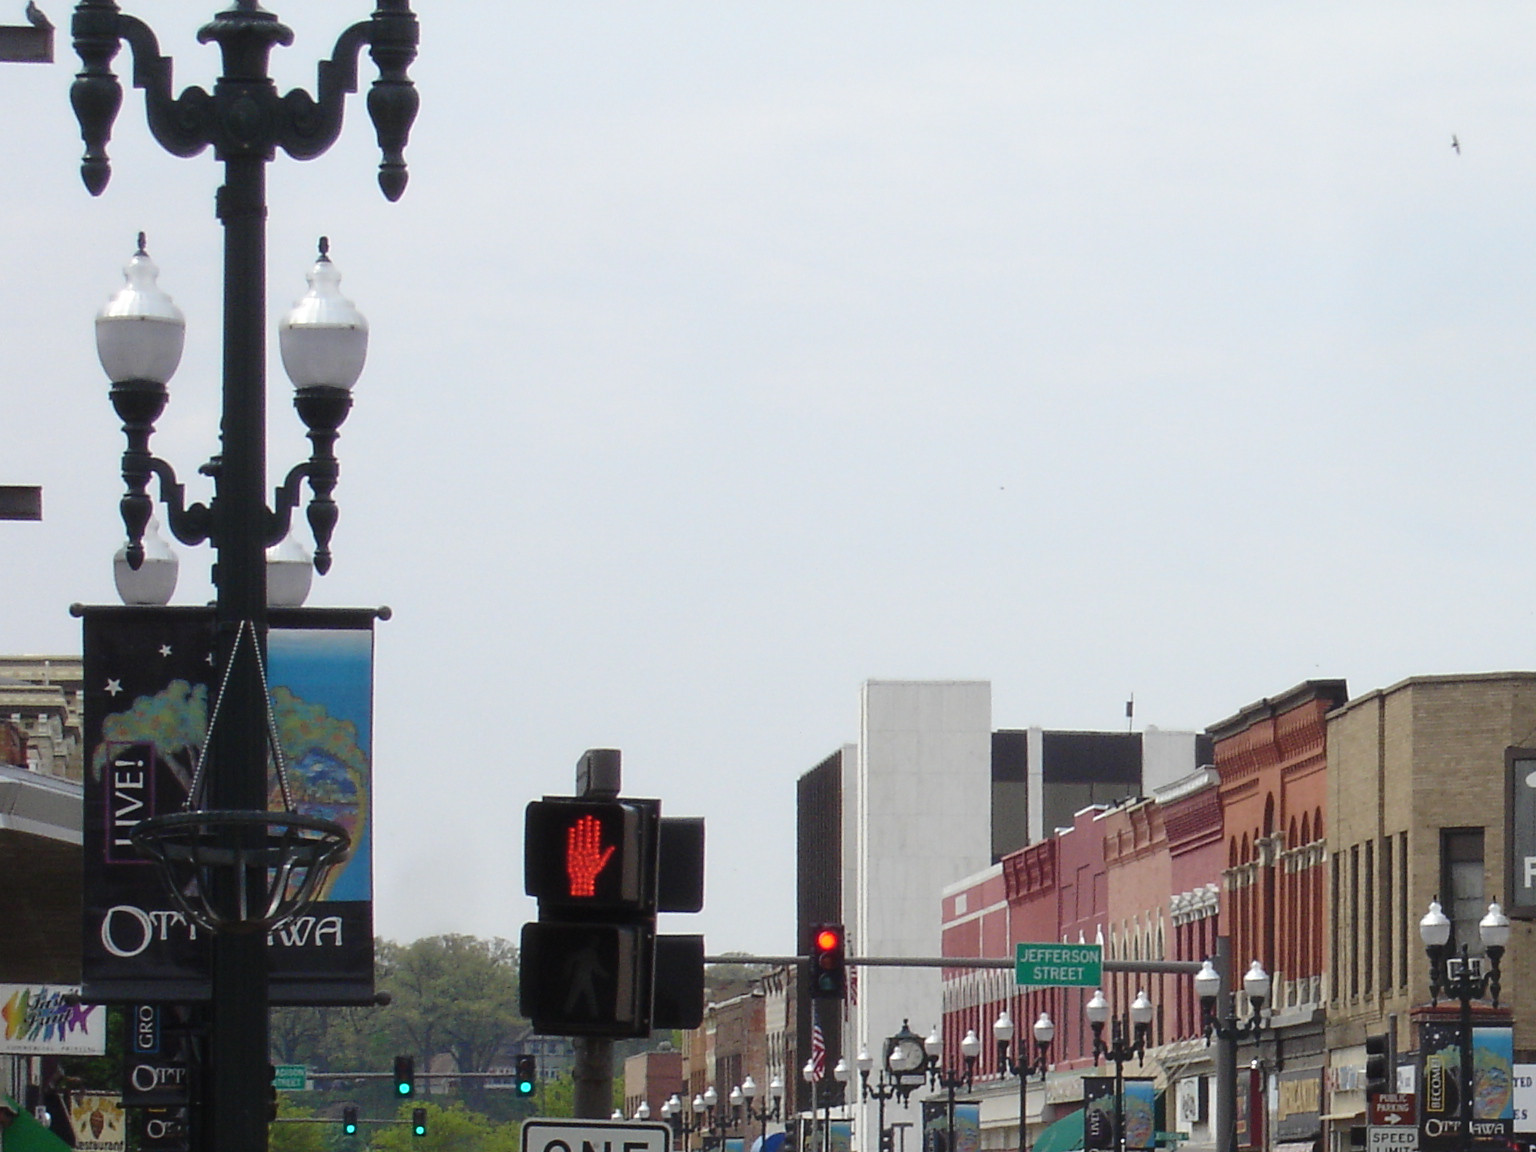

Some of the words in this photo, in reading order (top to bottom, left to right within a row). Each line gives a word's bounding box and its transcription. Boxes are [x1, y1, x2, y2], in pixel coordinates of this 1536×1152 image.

[101, 905, 343, 957] OTTWA
[1021, 949, 1099, 963] JEFFERSON
[1033, 966, 1085, 980] STREET
[1379, 1093, 1408, 1102] PUBLIC
[1376, 1103, 1410, 1112] PARKING
[1372, 1133, 1416, 1143] SPEED
